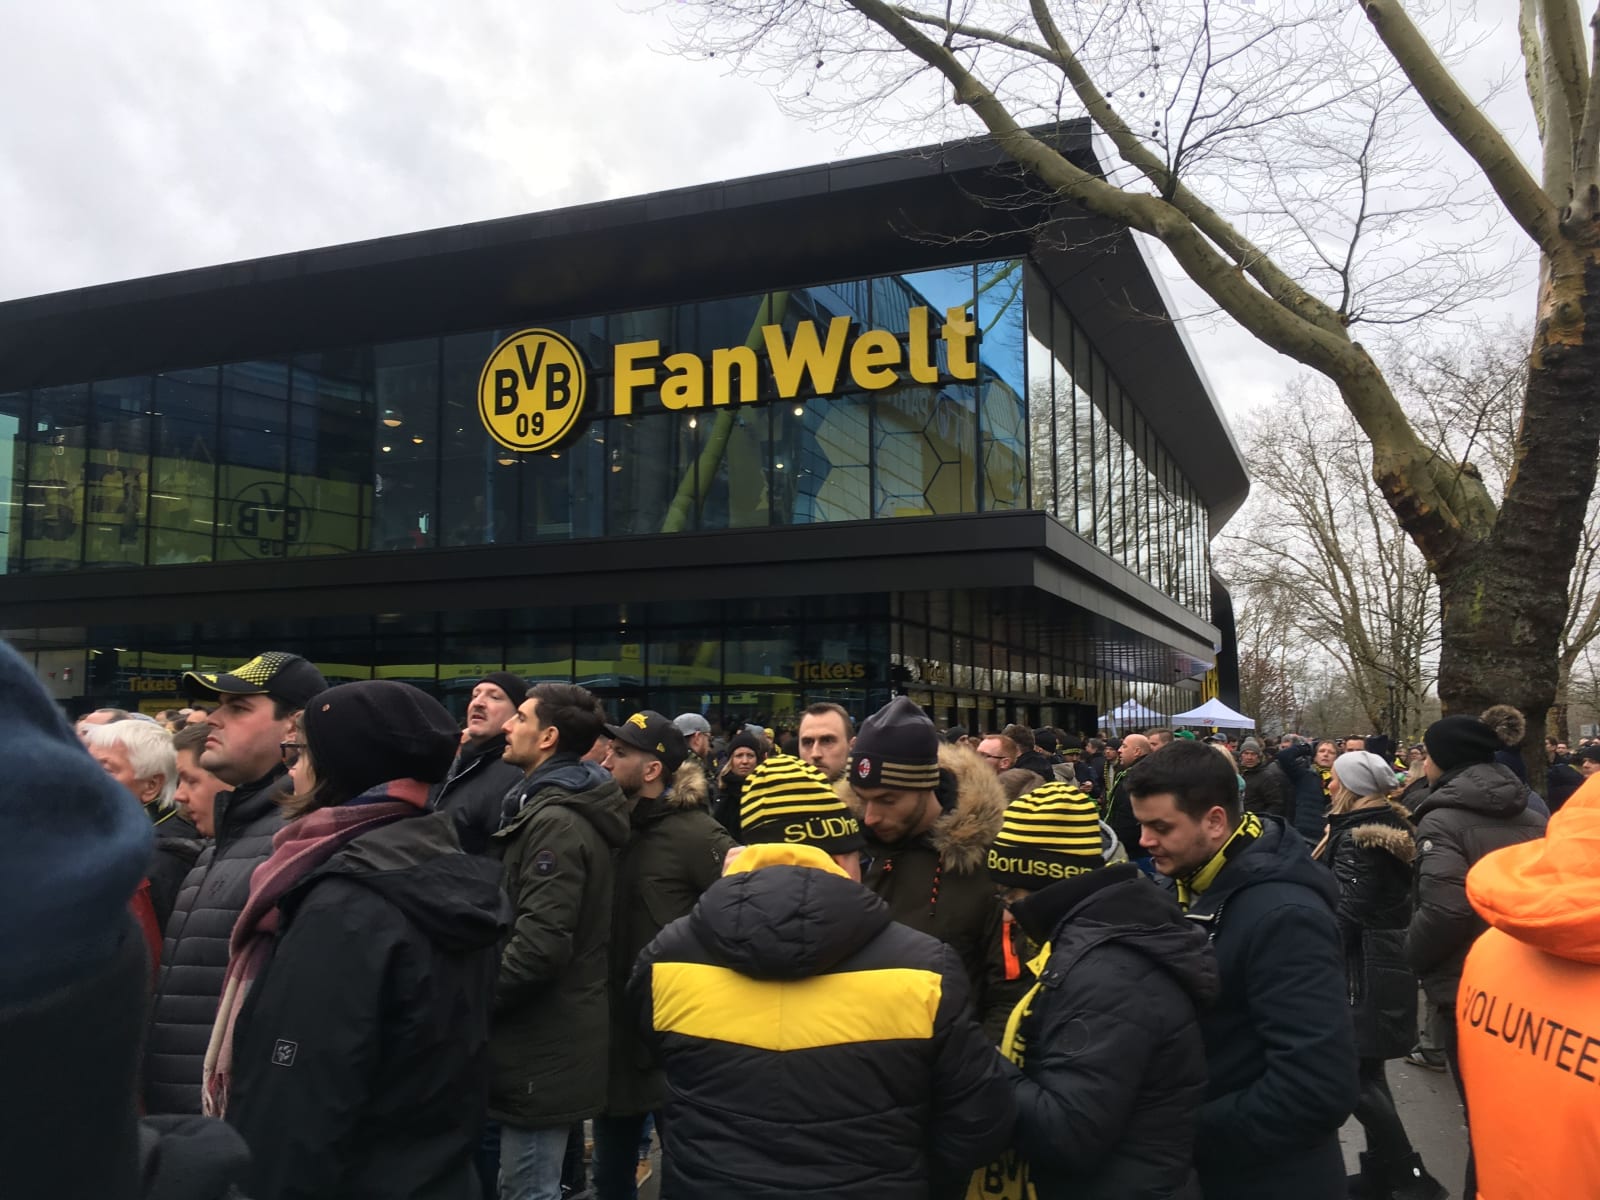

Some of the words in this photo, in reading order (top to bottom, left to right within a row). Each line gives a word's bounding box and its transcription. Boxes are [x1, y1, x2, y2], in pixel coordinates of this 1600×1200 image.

[494, 341, 571, 416] BVB
[613, 305, 977, 416] FanWelt
[516, 411, 544, 438] 09
[127, 676, 178, 692] Tickets
[792, 660, 866, 680] Tickets
[1463, 985, 1600, 1085] VOLUNTEE
